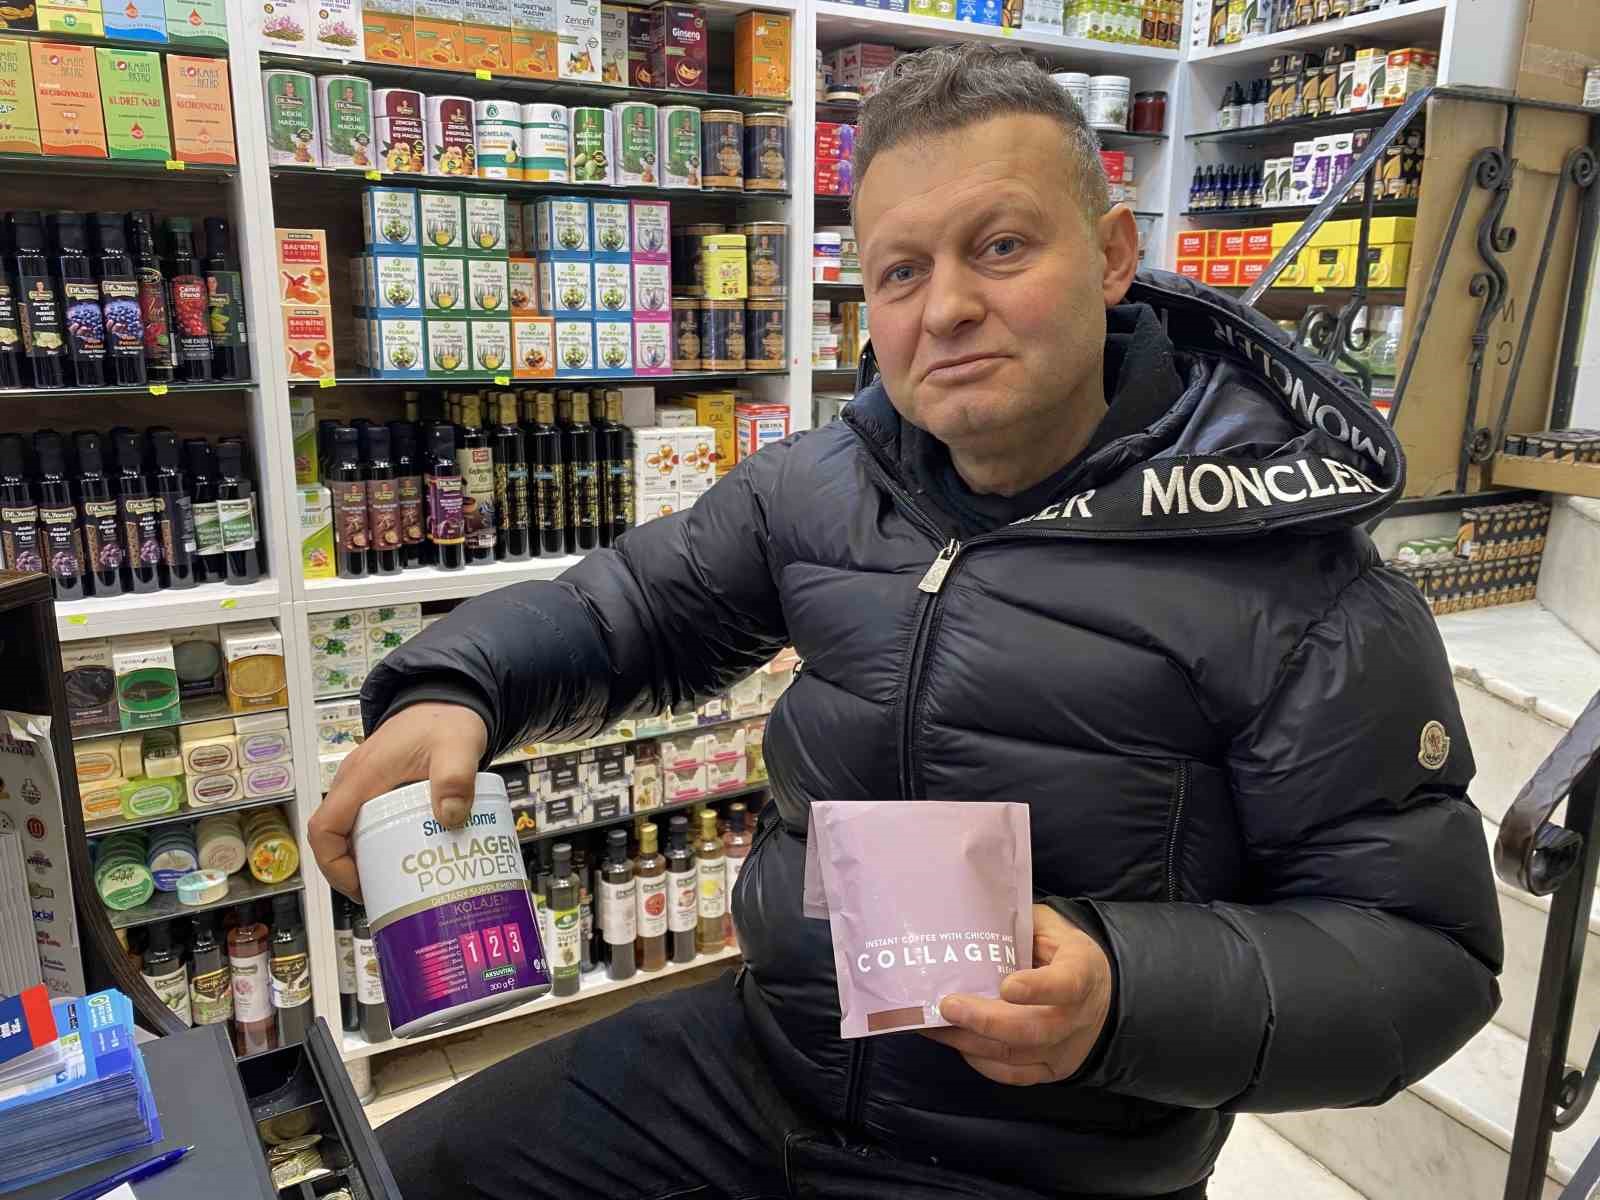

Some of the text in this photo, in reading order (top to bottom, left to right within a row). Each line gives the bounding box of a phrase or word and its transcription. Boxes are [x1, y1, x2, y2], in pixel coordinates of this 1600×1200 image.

[672, 27, 701, 41] Ginseng
[1142, 457, 1394, 518] MONCLER
[401, 835, 519, 874] COLLAGEN
[417, 854, 520, 892] POWDER
[467, 931, 521, 963] 1 2 3
[865, 936, 898, 949] INSTANT
[939, 931, 962, 941] WITH
[857, 942, 1017, 973] COLLAGEN
[489, 982, 503, 991] 300
